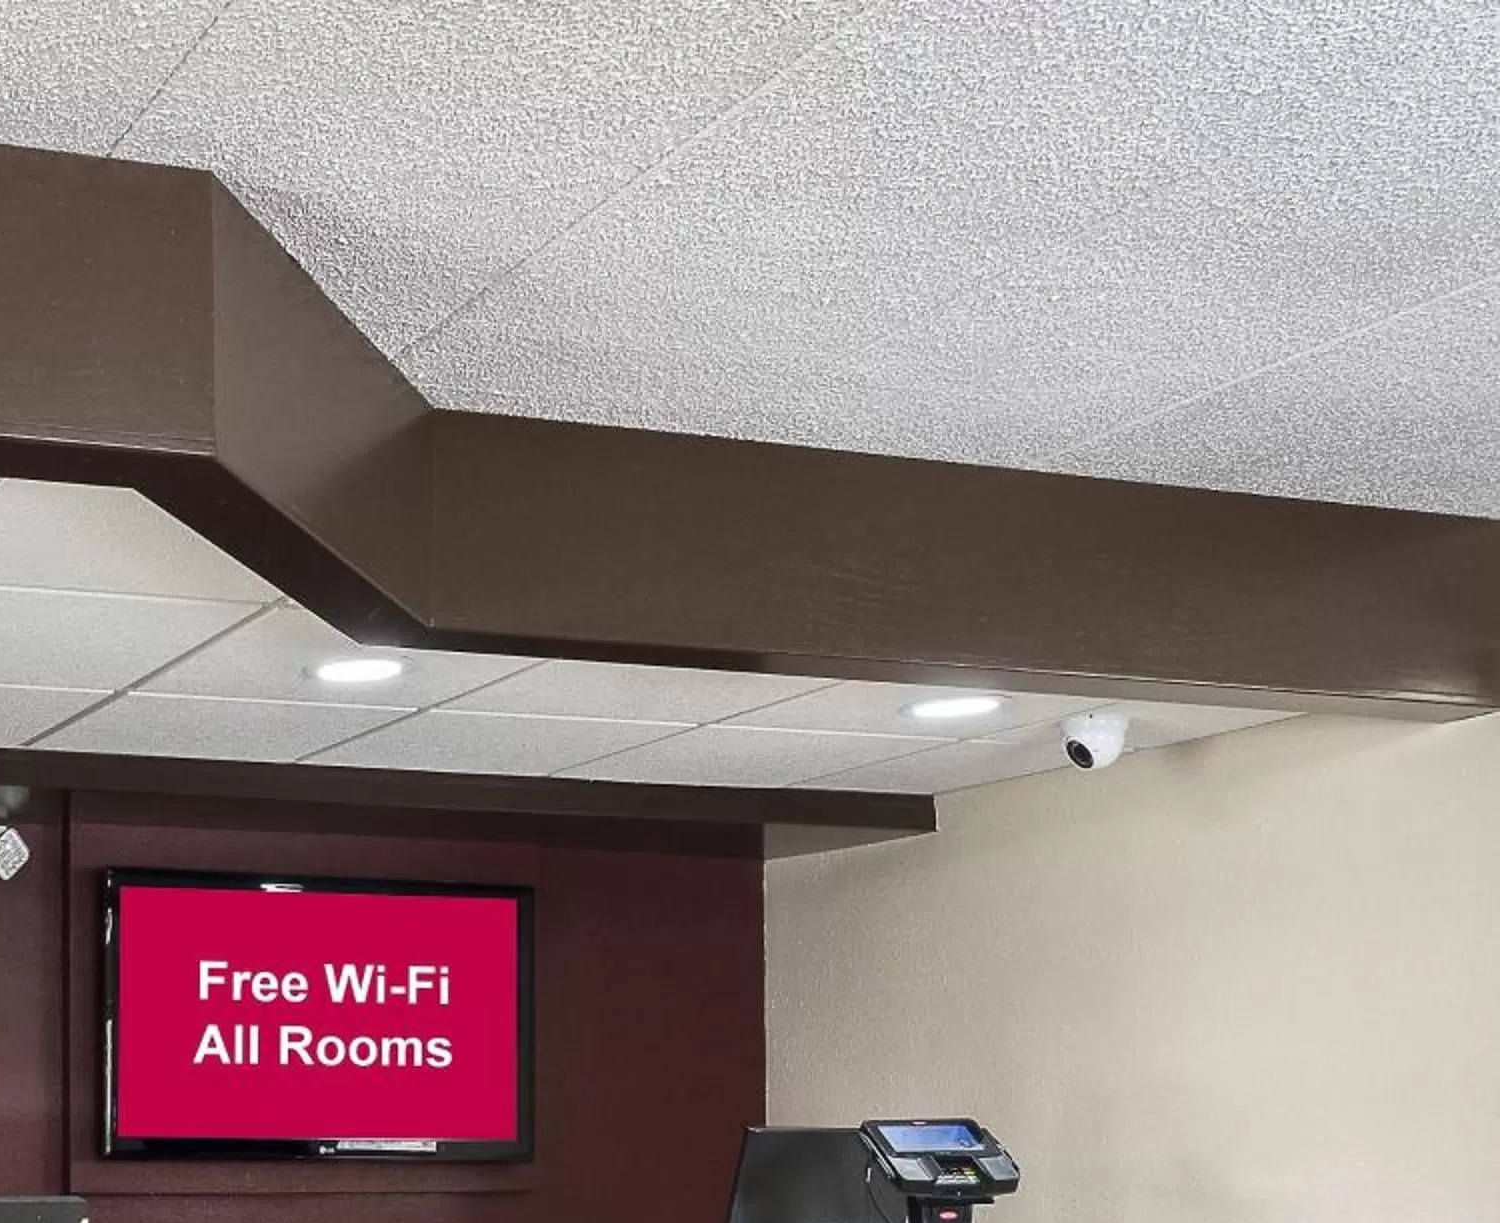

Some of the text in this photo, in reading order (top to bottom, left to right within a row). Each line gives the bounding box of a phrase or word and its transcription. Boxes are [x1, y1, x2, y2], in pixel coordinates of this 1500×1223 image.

[199, 960, 449, 1005] Free Wi-Fi
[193, 1023, 453, 1068] All Rooms
